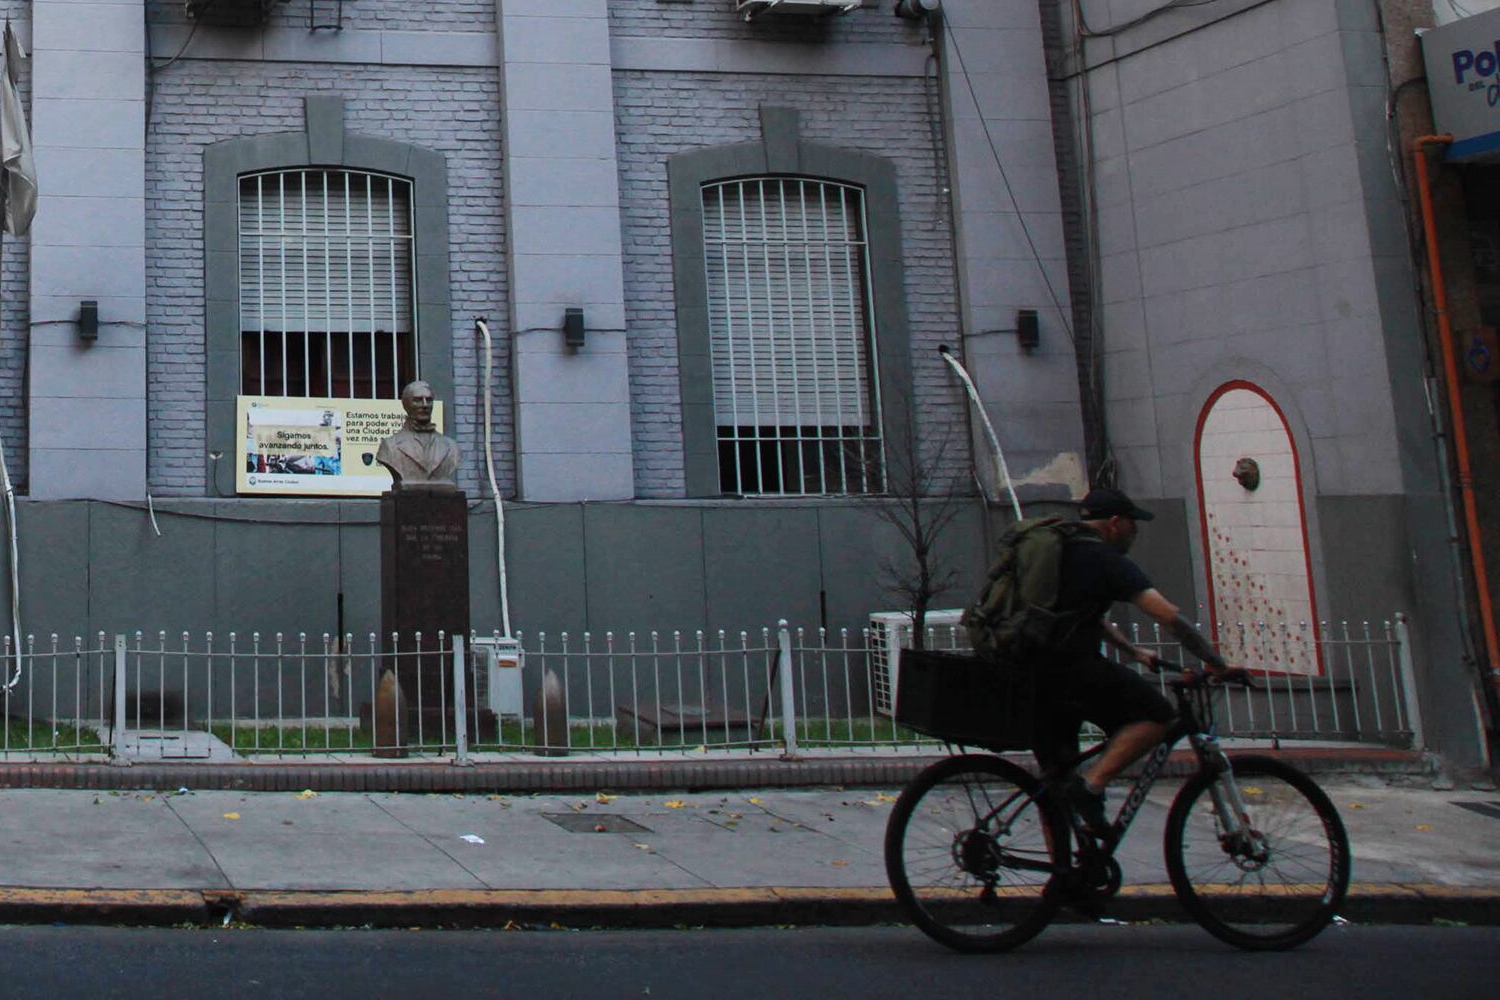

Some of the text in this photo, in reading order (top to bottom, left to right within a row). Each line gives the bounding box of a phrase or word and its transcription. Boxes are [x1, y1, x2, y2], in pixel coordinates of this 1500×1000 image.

[346, 411, 379, 419] Estamos
[346, 420, 364, 428] para
[366, 420, 389, 428] poder
[363, 427, 390, 435] Ciudad
[277, 431, 312, 440] Sigamos
[259, 441, 302, 450] avanzando
